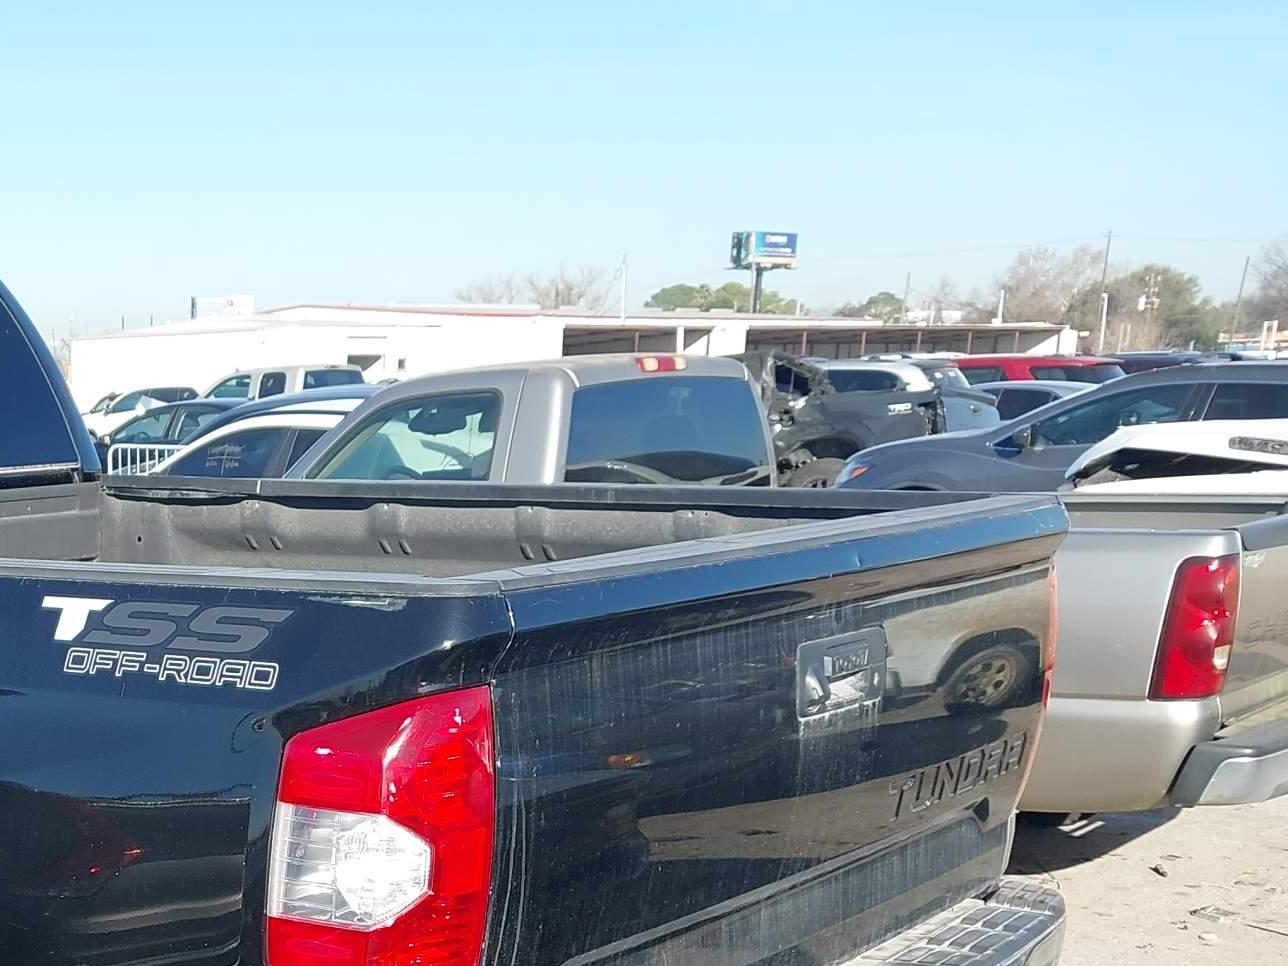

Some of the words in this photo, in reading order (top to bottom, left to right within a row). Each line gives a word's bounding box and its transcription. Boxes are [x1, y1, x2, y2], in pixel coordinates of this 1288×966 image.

[40, 595, 296, 654] TSS
[63, 647, 280, 690] OFF-ROAD
[888, 731, 1027, 823] TUNDRA
